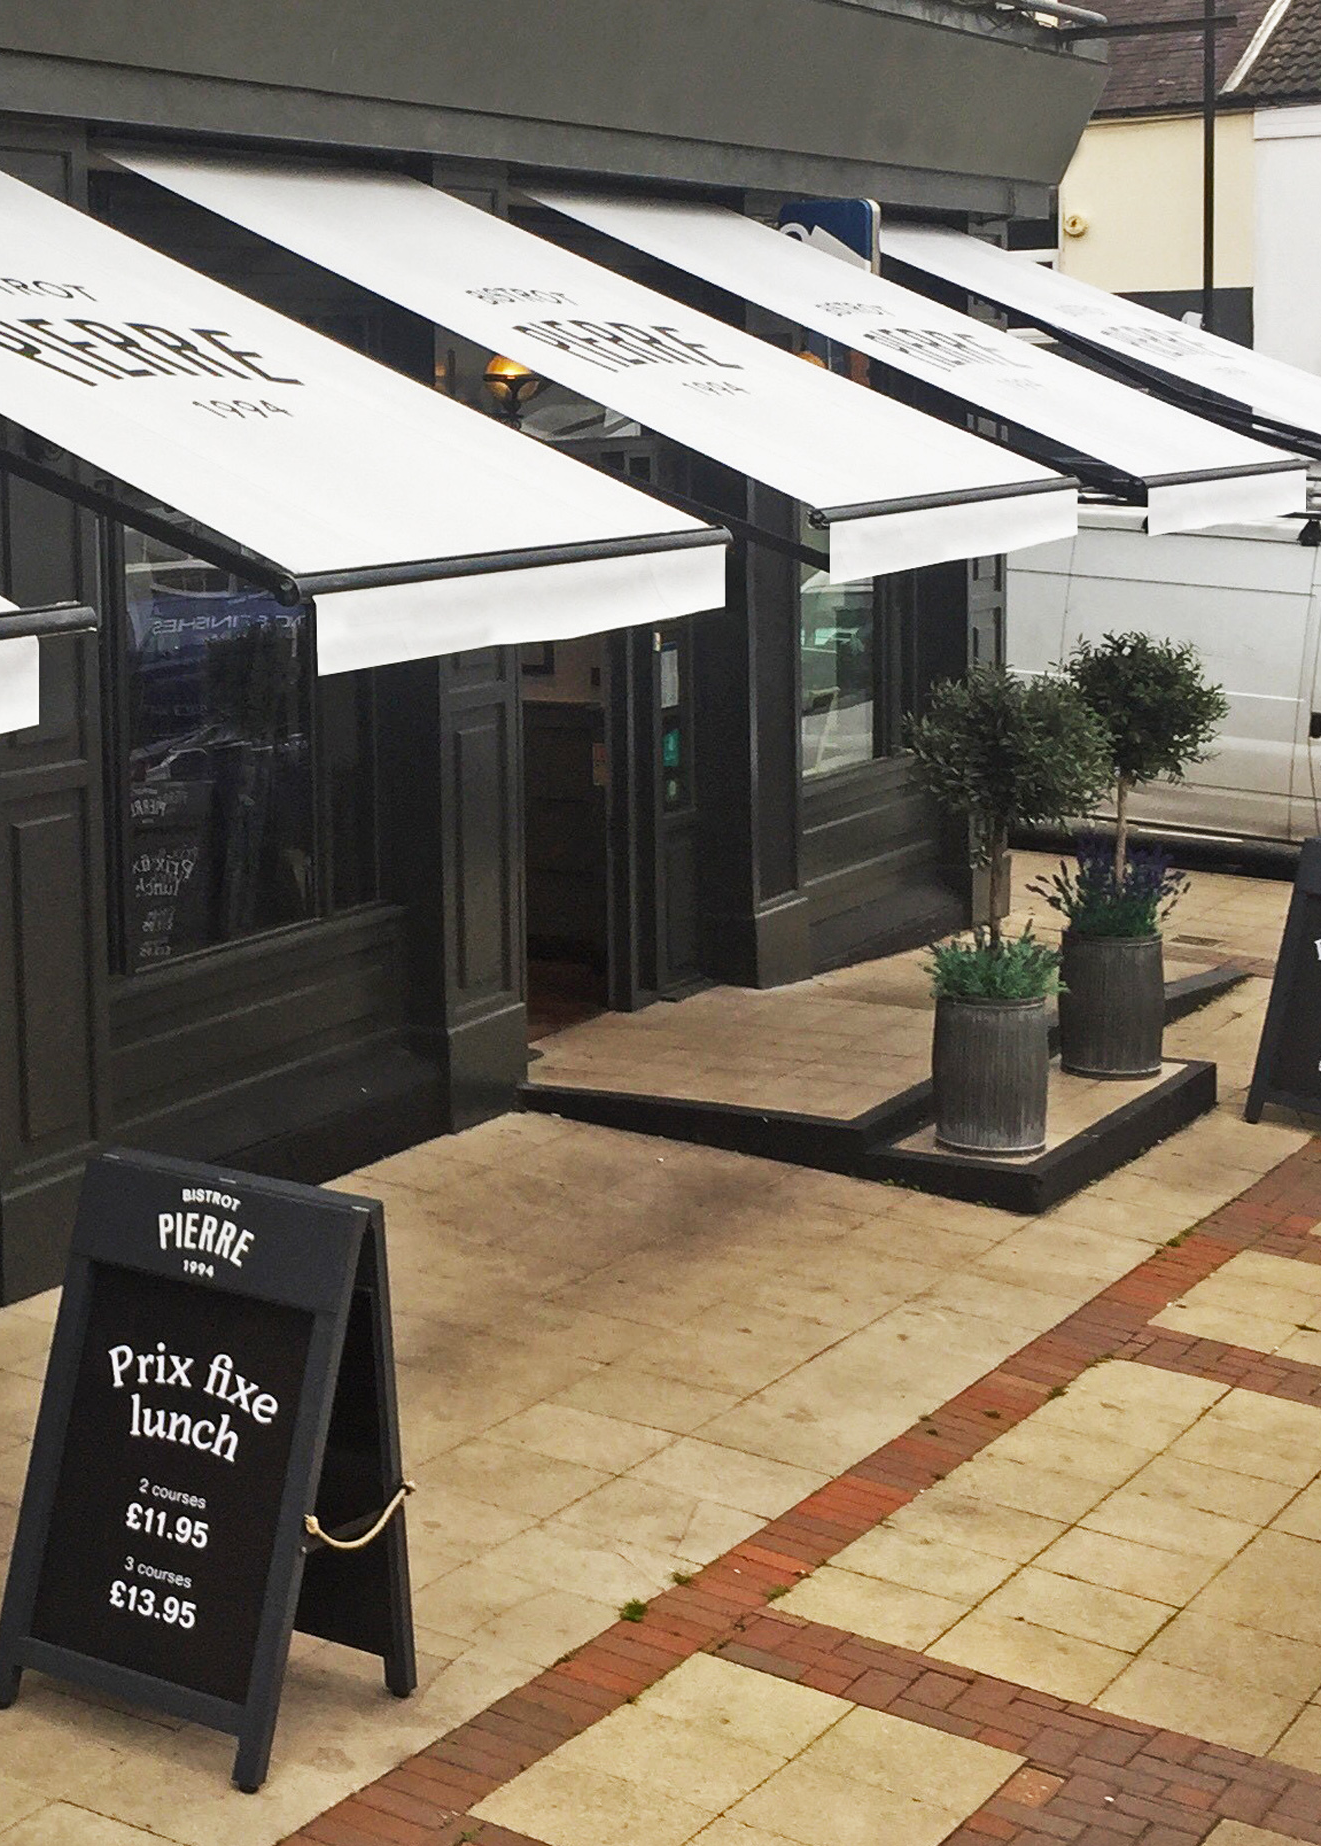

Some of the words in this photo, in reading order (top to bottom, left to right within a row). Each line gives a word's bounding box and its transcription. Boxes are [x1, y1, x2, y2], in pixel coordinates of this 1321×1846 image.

[511, 319, 744, 373] PIERRE
[192, 399, 293, 418] 1994
[182, 1187, 241, 1212] BISTROT
[158, 1211, 255, 1269] PIERRE
[183, 1259, 215, 1278] 1994
[107, 1341, 194, 1388] Prix
[202, 1353, 279, 1424] fixe
[129, 1394, 240, 1463] lunch
[139, 1477, 150, 1494] 2
[151, 1484, 207, 1511] courses
[125, 1502, 209, 1549] £11.95
[124, 1555, 135, 1572] 3
[137, 1563, 193, 1590] courses
[108, 1579, 197, 1629] £13.95
